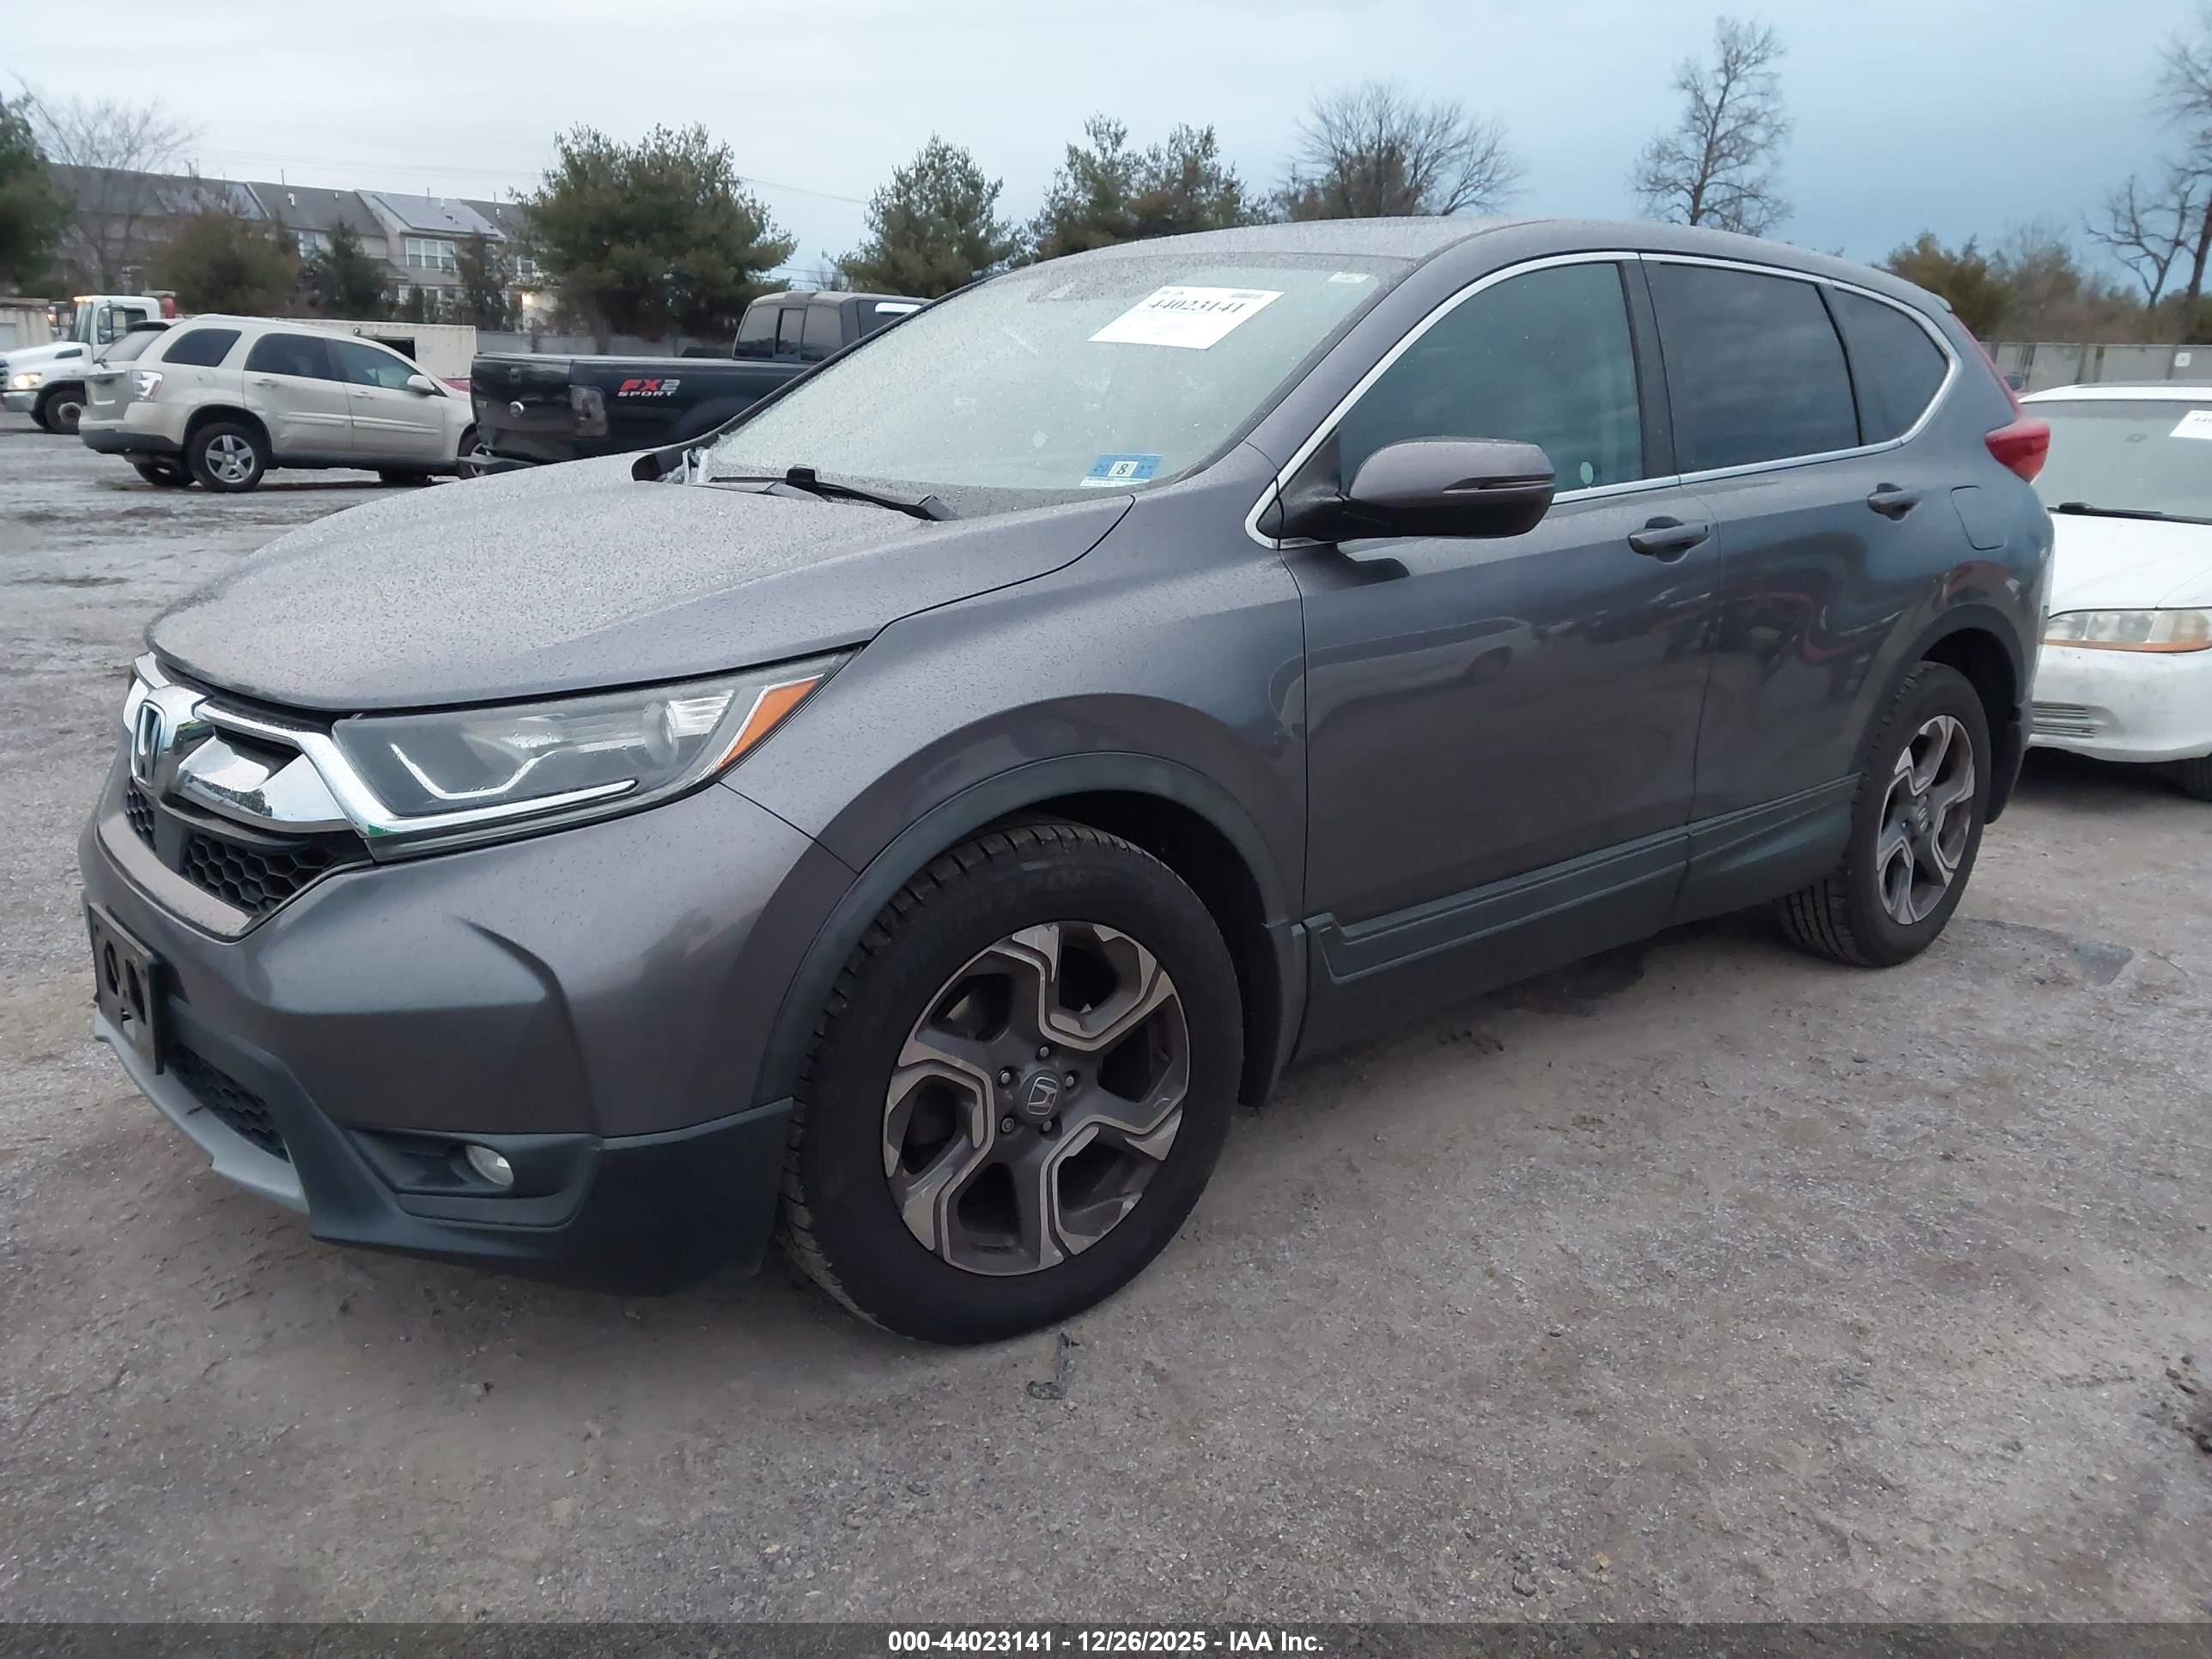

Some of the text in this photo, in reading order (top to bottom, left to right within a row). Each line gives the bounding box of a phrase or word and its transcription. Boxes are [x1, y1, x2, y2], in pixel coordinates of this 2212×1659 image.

[1148, 300, 1246, 313] 44023141
[619, 379, 680, 391] FX2
[1116, 464, 1128, 475] 8
